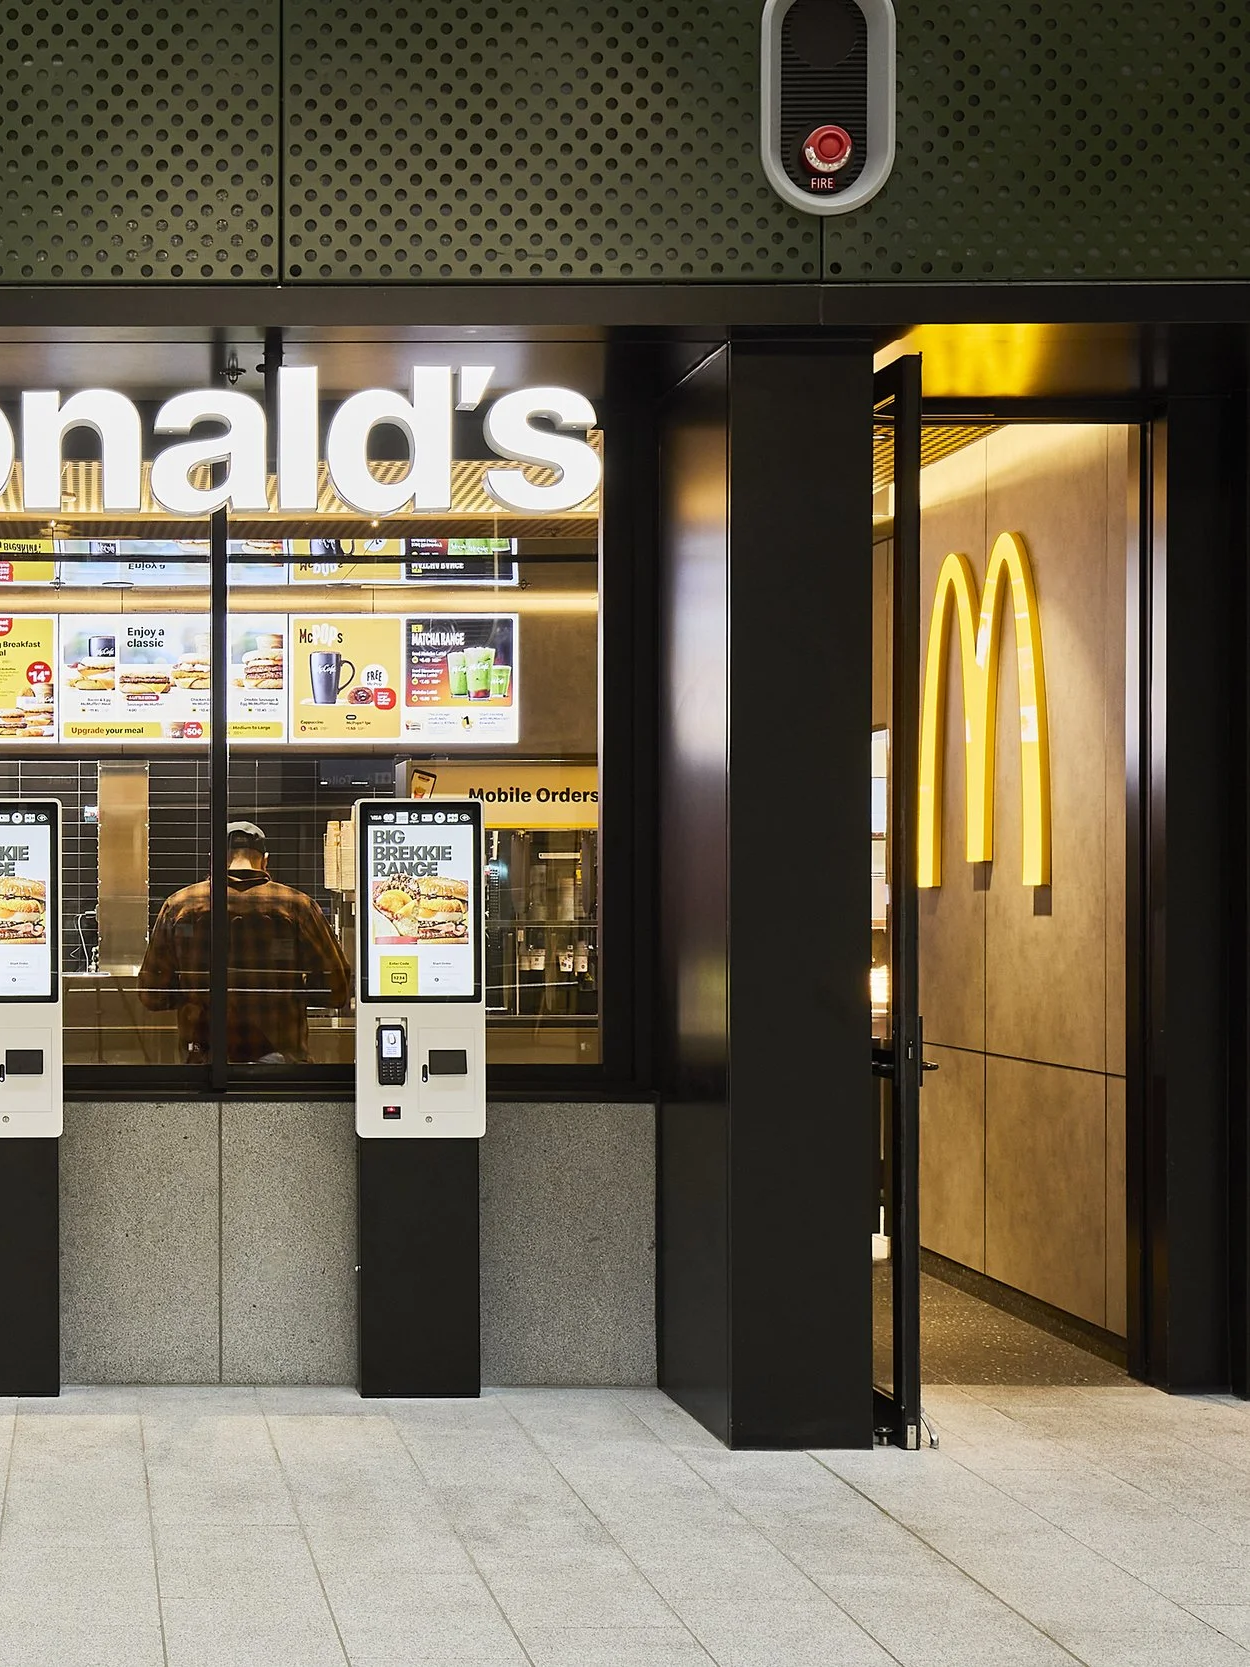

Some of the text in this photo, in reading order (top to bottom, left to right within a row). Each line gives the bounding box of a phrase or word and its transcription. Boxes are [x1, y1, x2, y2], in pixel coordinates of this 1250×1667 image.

[810, 177, 834, 189] FIRE
[127, 627, 156, 638] Enjoy
[440, 632, 465, 646] RANGE
[127, 638, 164, 648] classic
[366, 669, 382, 682] FREE
[71, 727, 104, 735] Upgrade
[468, 787, 599, 803] Mobile Orders
[373, 830, 406, 845] BIG
[373, 845, 452, 861] BREKKIE
[373, 861, 438, 877] RANGE
